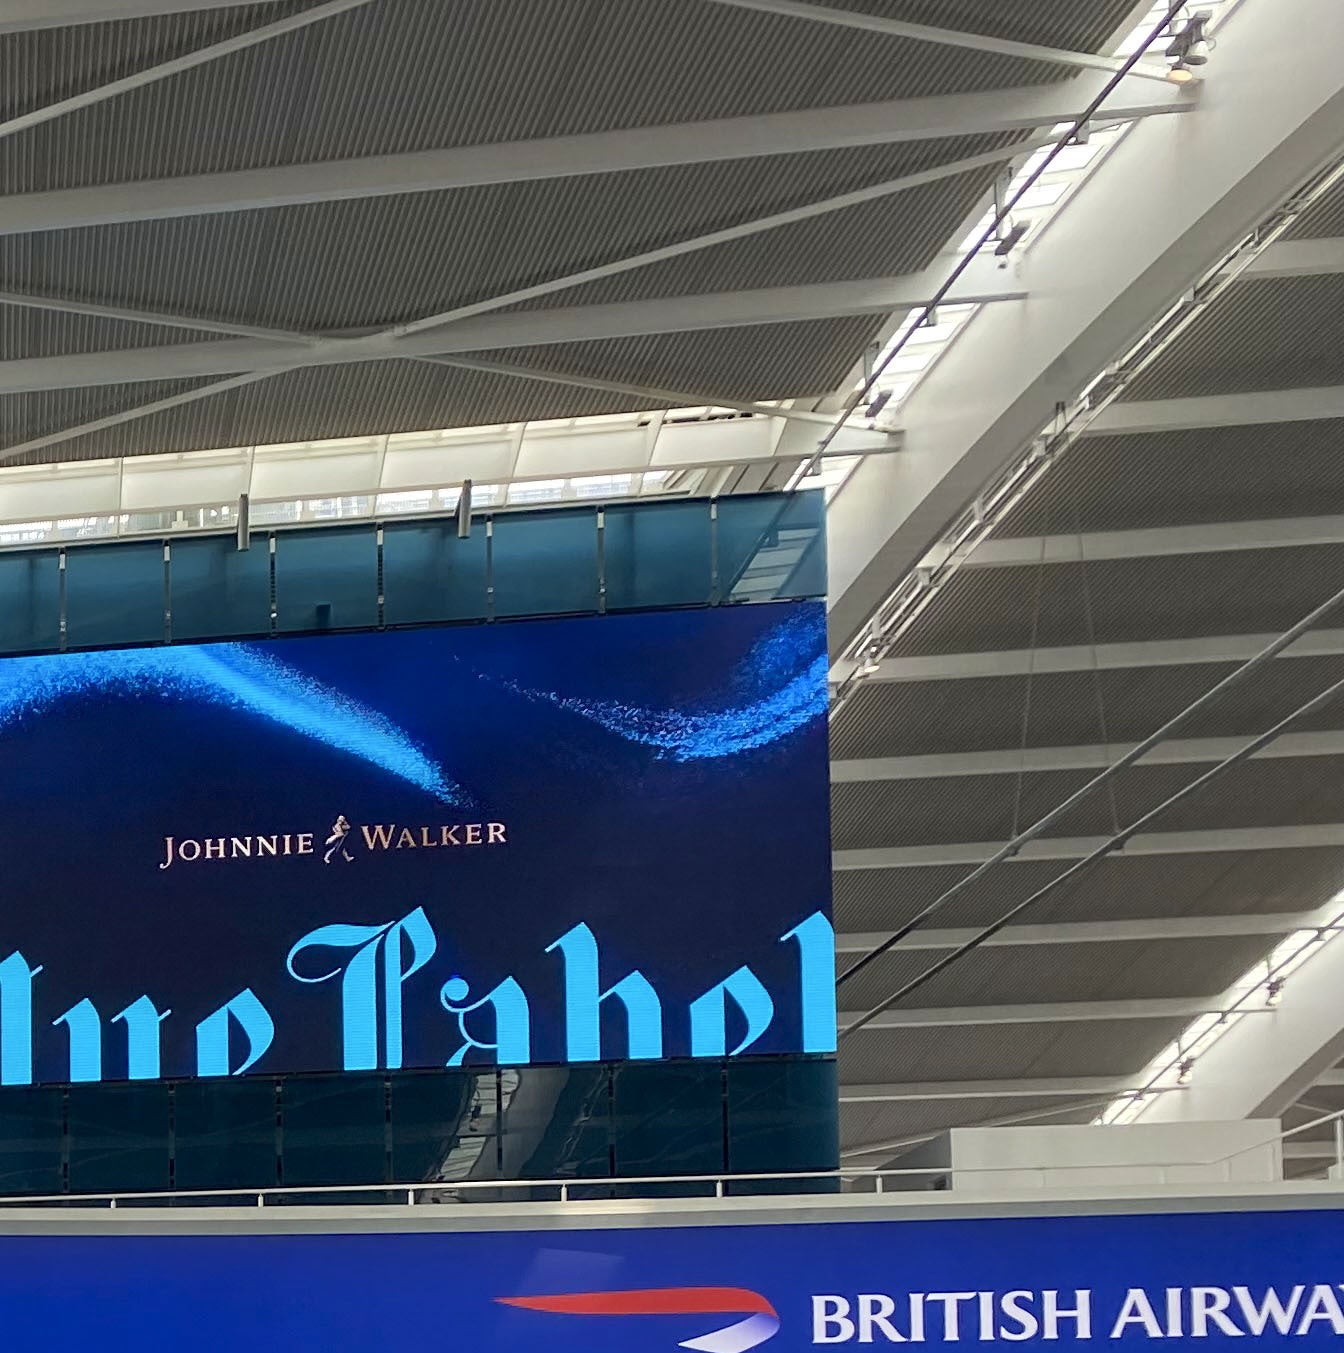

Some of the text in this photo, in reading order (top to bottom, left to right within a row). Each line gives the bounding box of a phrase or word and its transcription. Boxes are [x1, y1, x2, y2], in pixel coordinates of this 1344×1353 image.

[160, 822, 507, 870] JOHNNIE WALKER
[811, 1284, 1344, 1344] BRITISH AIRWA
